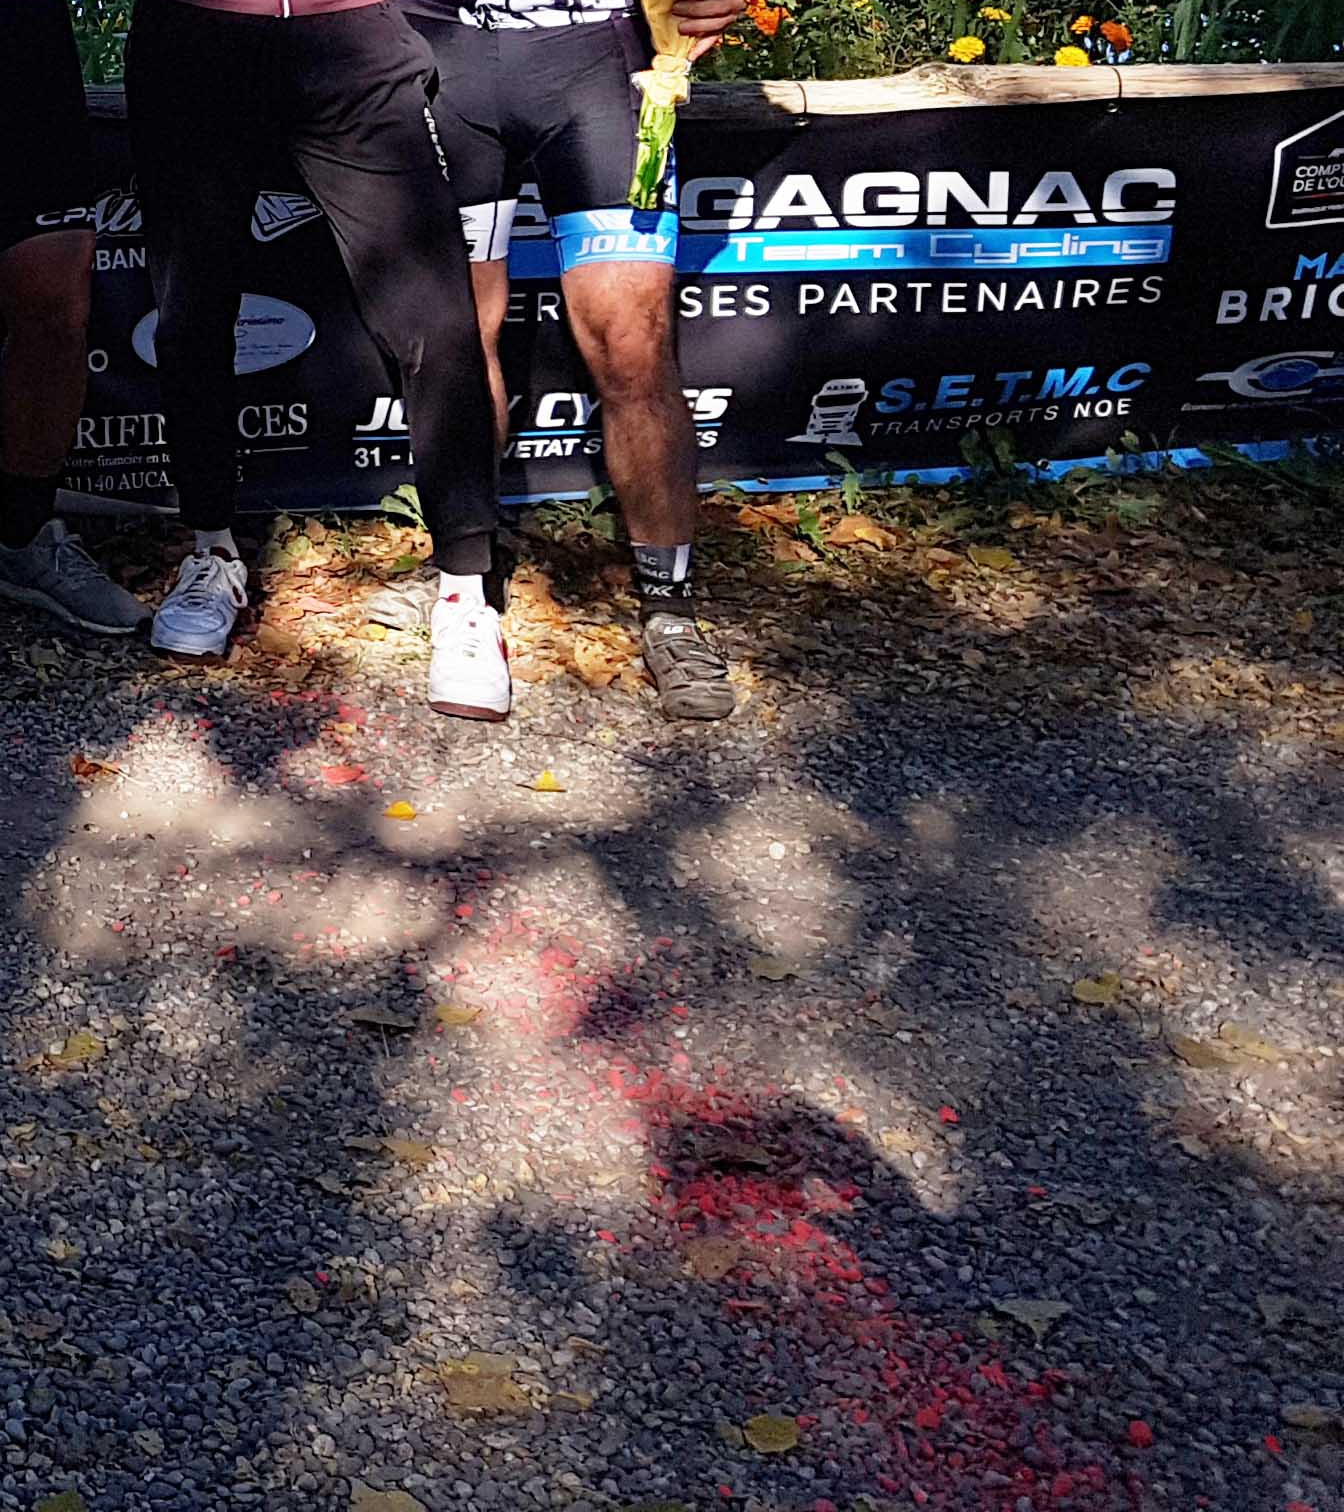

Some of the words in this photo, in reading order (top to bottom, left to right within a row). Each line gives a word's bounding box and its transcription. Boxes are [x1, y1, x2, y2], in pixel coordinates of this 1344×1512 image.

[679, 168, 1178, 231] GAGNAC
[1293, 178, 1316, 193] DE
[576, 234, 672, 258] JOLLY
[728, 237, 905, 263] Team
[929, 232, 1165, 265] Cycling
[679, 284, 772, 319] SES
[798, 275, 1165, 316] PARTENAIRES
[874, 362, 1153, 415] S.E.T.M.C
[869, 405, 1060, 436] TRANSPORTS
[1073, 397, 1133, 419] NOE
[97, 453, 144, 467] financier
[146, 455, 160, 465] en
[353, 447, 382, 468] 31
